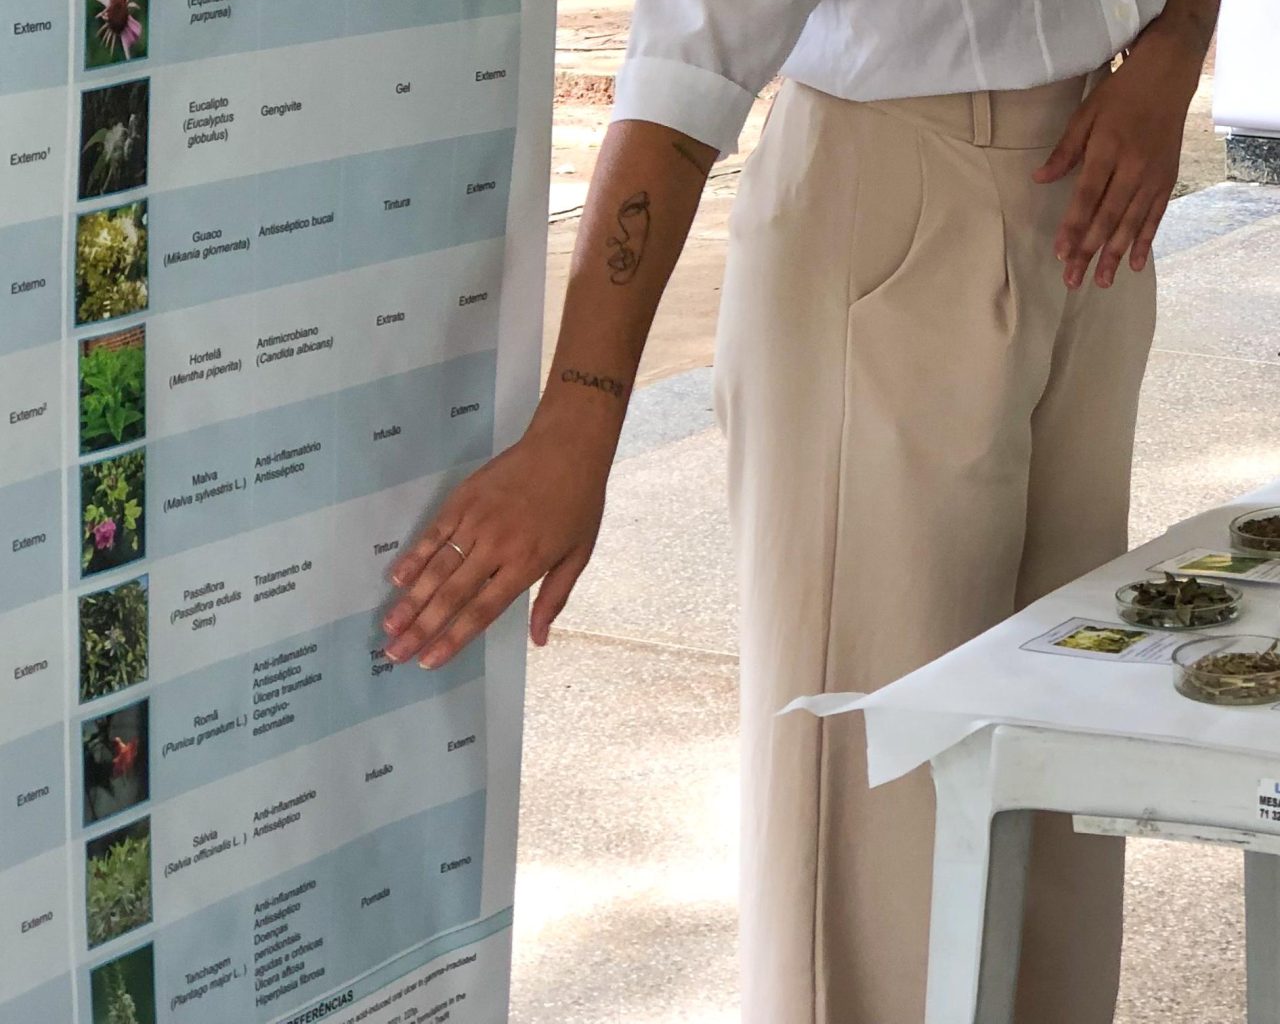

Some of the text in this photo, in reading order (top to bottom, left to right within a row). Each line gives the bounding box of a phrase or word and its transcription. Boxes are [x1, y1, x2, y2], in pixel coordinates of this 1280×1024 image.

[189, 97, 229, 113] Eucalipto
[260, 101, 302, 116] Gengivite
[183, 113, 234, 132] (Eucalyptus
[187, 128, 228, 148] globulus)
[383, 198, 411, 210] Tintura
[258, 211, 334, 237] Antisséptico bucal
[192, 229, 222, 243] Guaco
[11, 278, 46, 294] Externo
[376, 312, 405, 326] Extrato
[256, 326, 318, 349] Antimicrobiano
[189, 348, 221, 365] Hortelã
[450, 402, 480, 418] Externo
[373, 425, 401, 441] Infusão
[192, 471, 218, 486] Malva
[12, 533, 46, 552] Externo
[254, 564, 300, 586] Tratamento
[183, 581, 225, 601] Passiflora
[1260, 808, 1269, 818] 71
